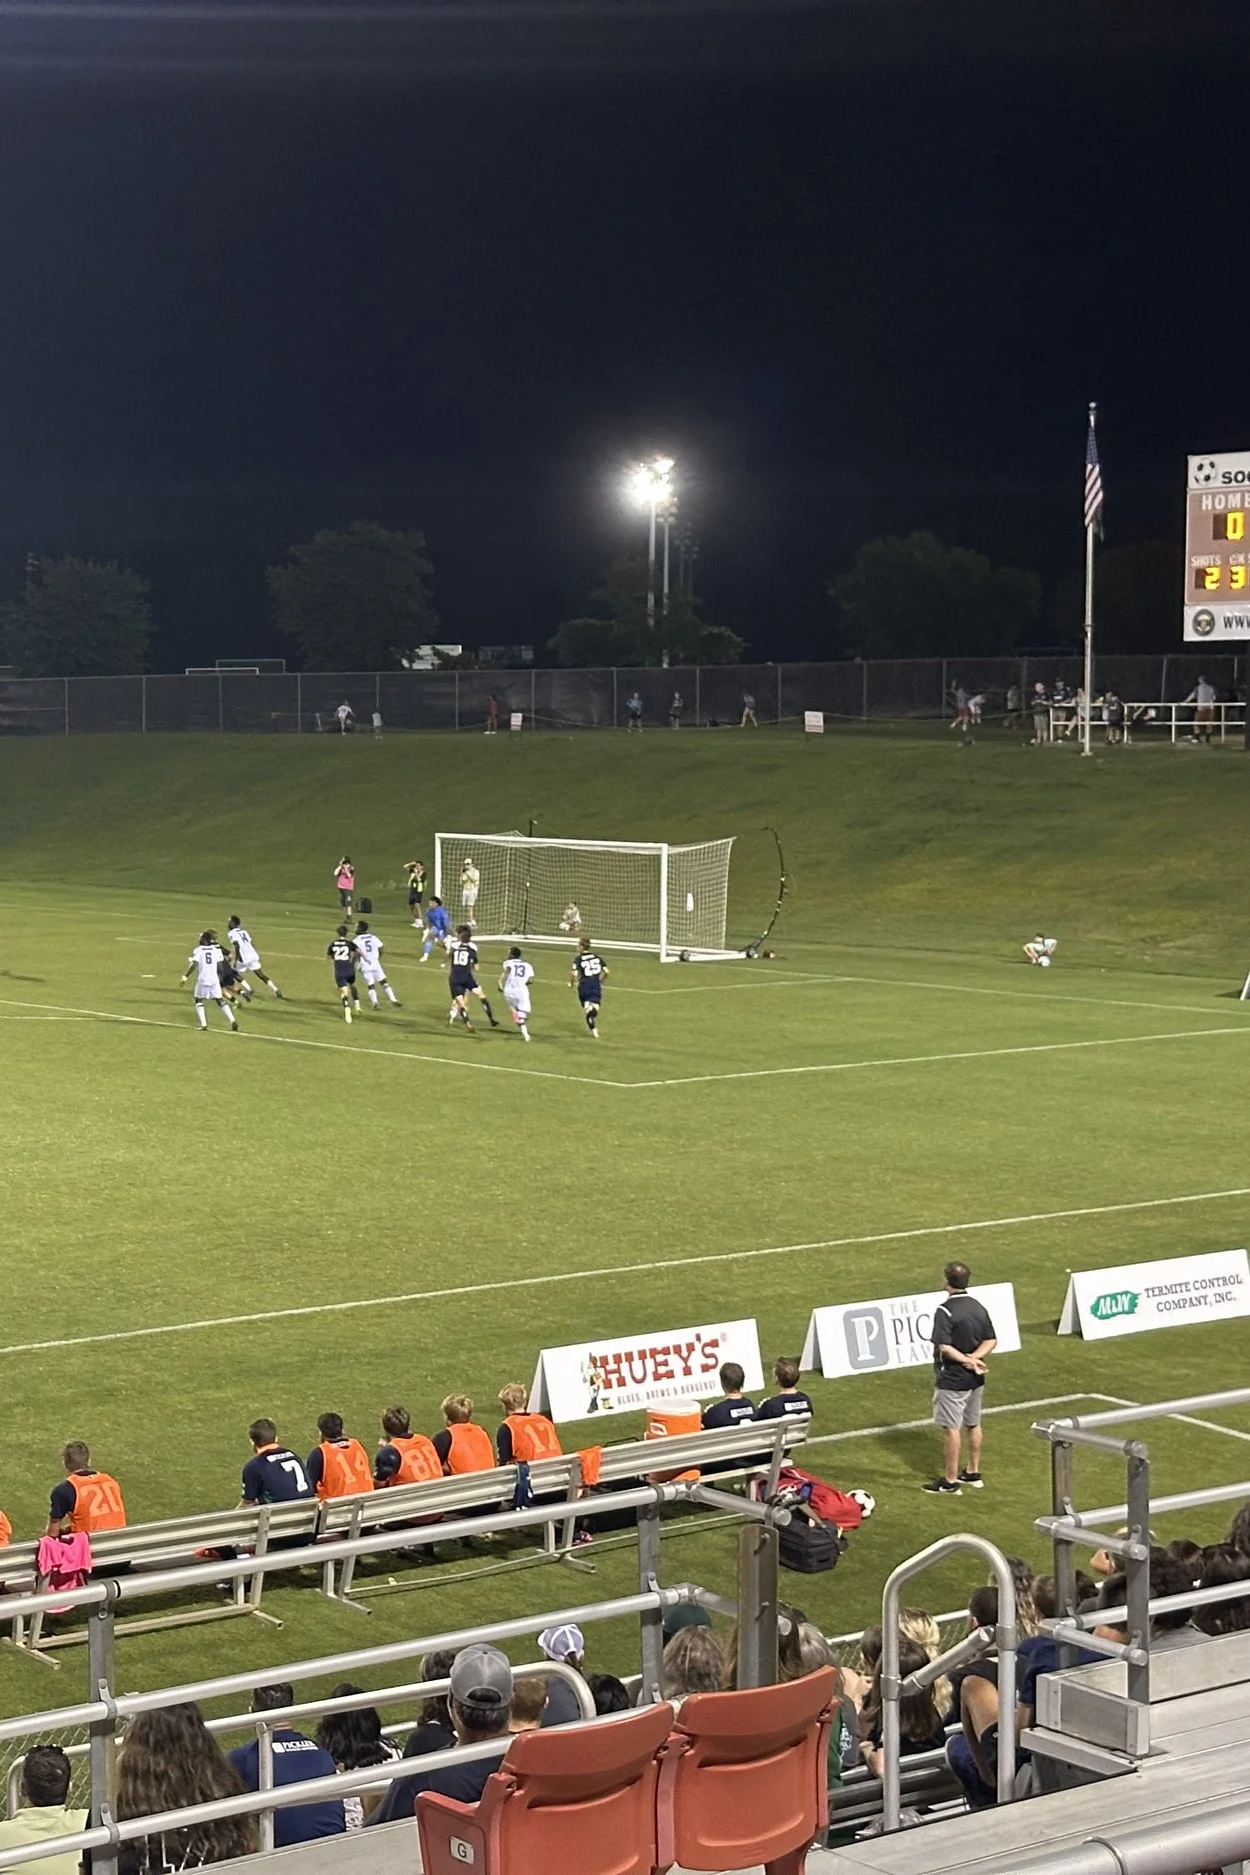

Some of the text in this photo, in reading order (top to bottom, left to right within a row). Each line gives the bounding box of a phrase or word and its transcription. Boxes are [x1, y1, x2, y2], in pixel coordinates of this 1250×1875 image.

[1226, 511, 1244, 540] 0
[332, 946, 349, 961] 22
[513, 964, 526, 978] 13
[581, 958, 601, 977] 25
[1144, 1273, 1243, 1298] TERMITE CONTROL
[888, 1300, 919, 1316] THE
[1156, 1291, 1237, 1312] COMPANY, INC.
[891, 1313, 932, 1345] PIC
[600, 1333, 719, 1390] HUEY'S
[280, 1459, 308, 1492] 7
[80, 1481, 124, 1517] 20
[457, 1843, 467, 1858] G
